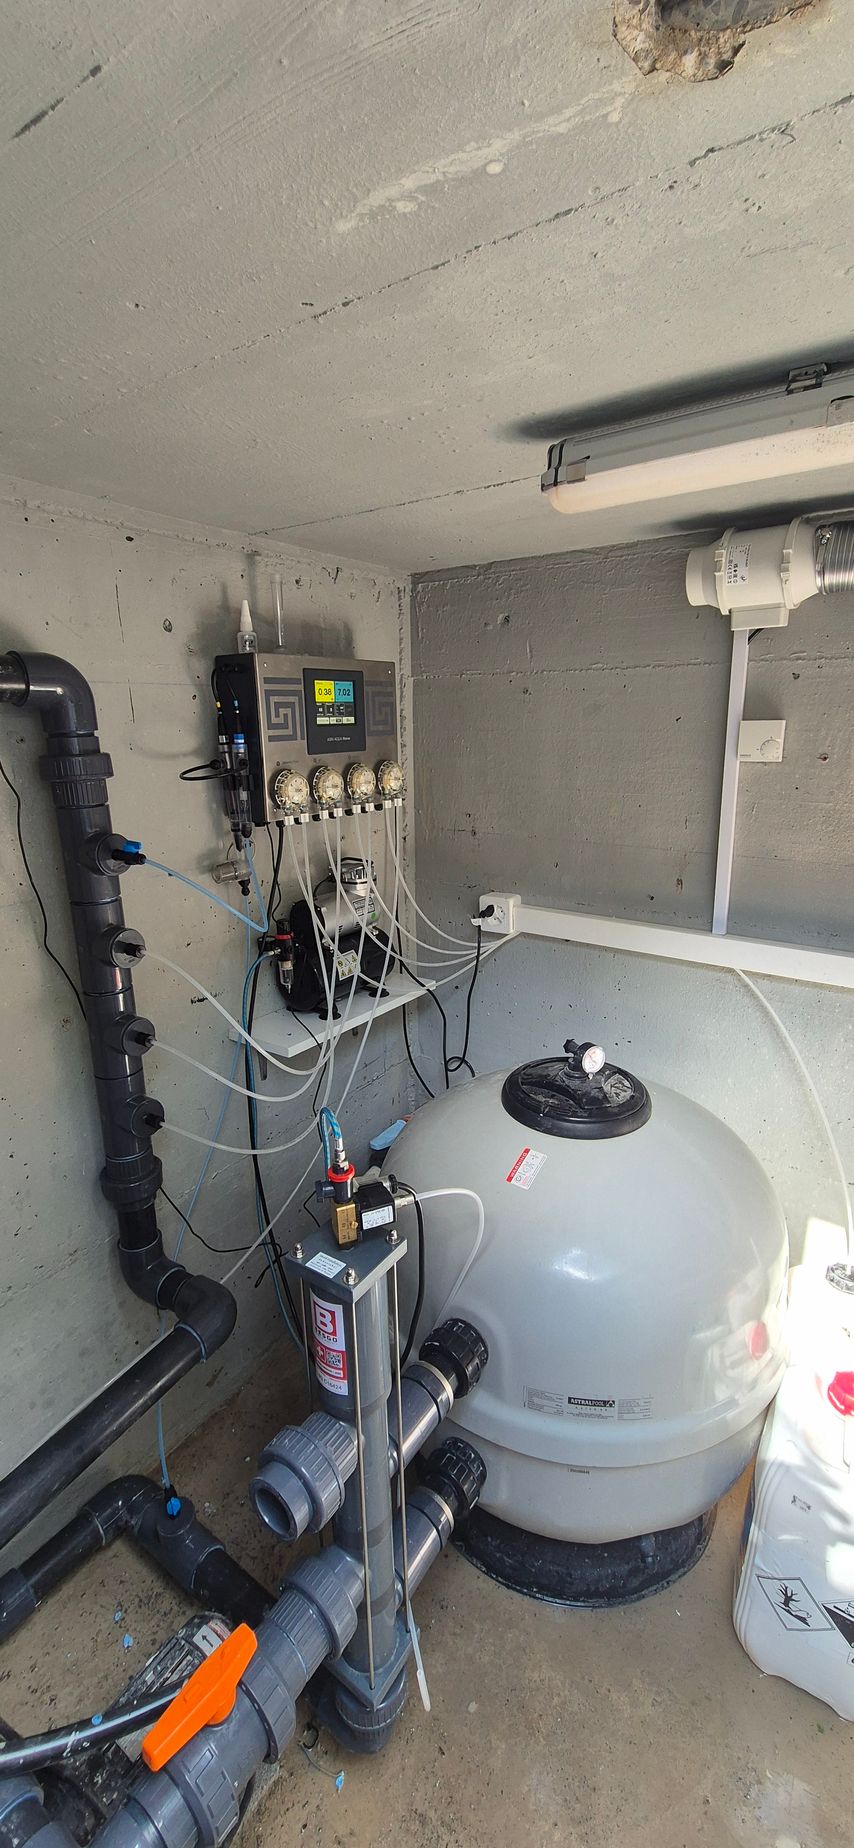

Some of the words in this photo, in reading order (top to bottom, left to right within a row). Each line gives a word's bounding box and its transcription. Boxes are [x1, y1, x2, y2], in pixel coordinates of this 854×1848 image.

[337, 688, 351, 697] 7.02
[316, 1305, 334, 1333] B
[570, 1398, 605, 1407] ASTRALPOOL
